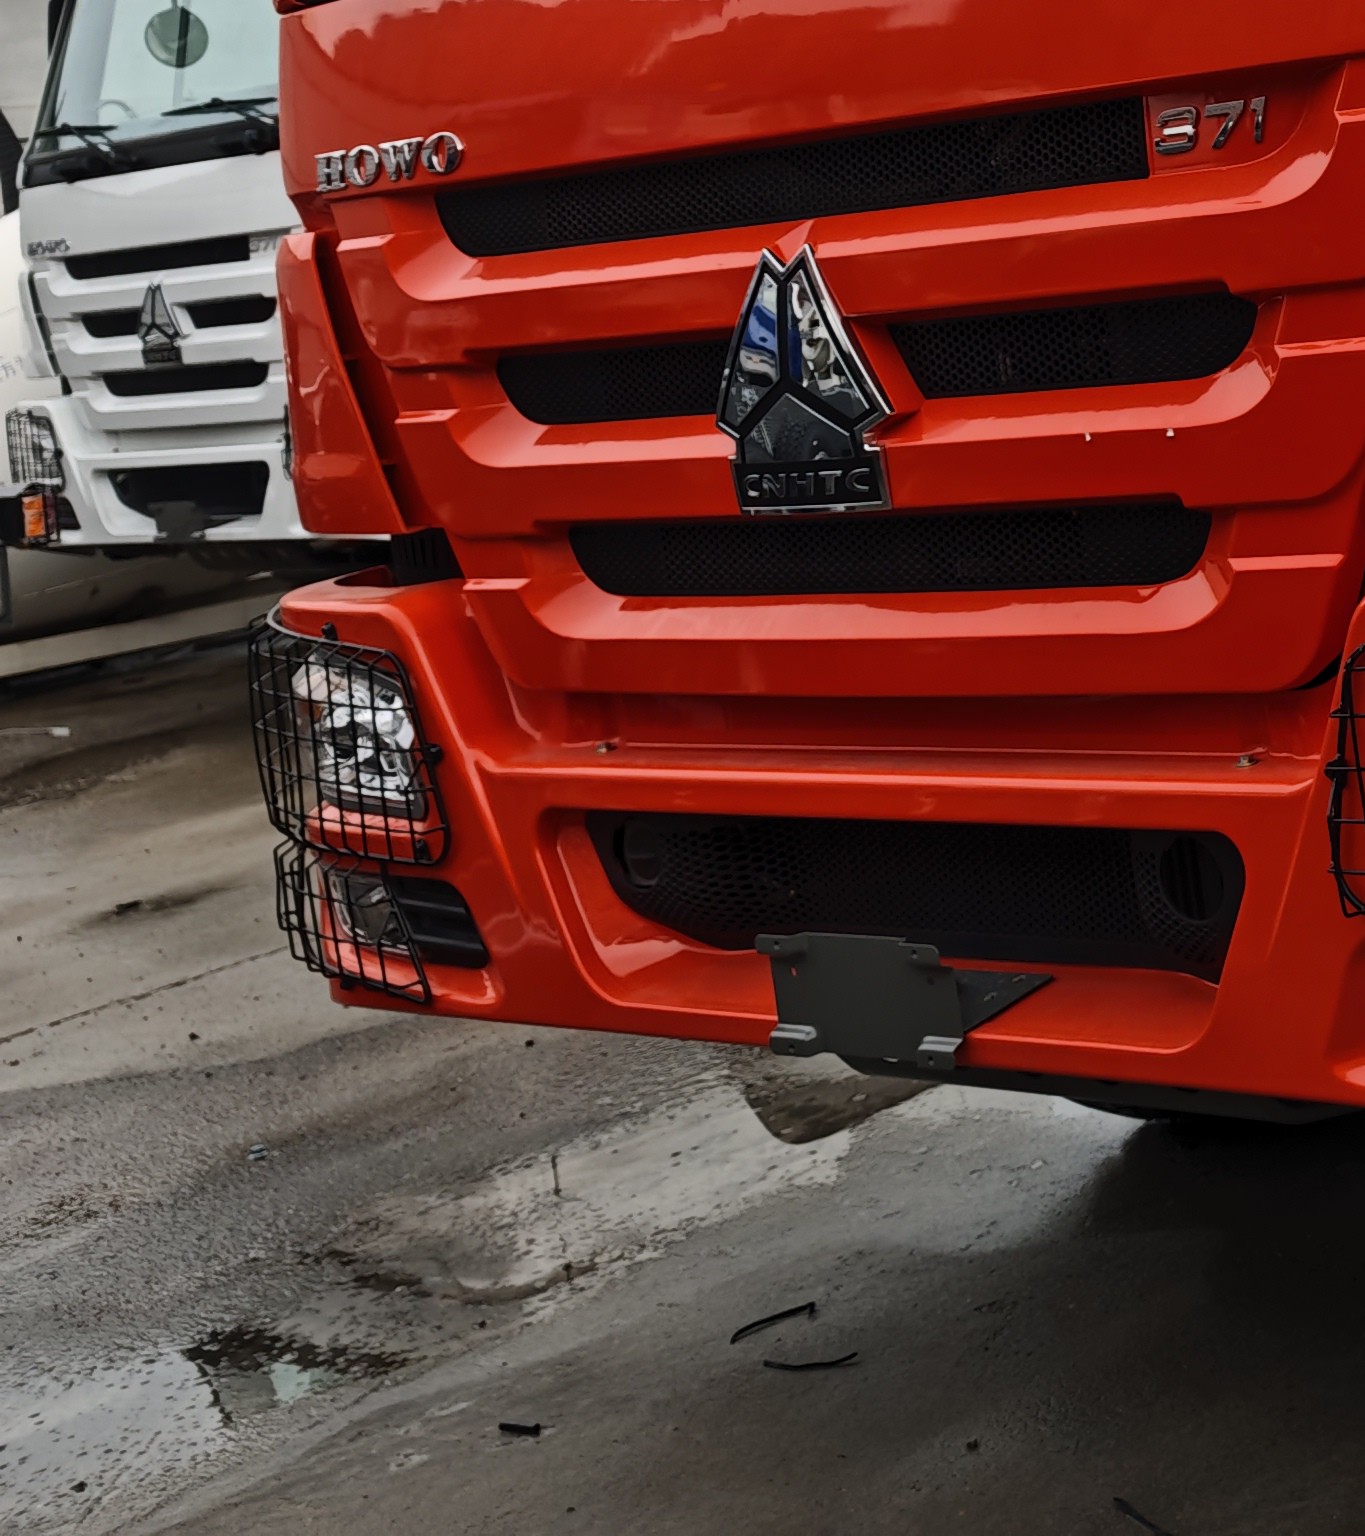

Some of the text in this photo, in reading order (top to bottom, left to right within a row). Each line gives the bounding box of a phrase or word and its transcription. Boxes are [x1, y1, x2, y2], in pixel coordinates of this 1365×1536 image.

[1154, 96, 1266, 154] 371
[314, 131, 465, 192] HOWO
[743, 467, 871, 498] CNHTC
